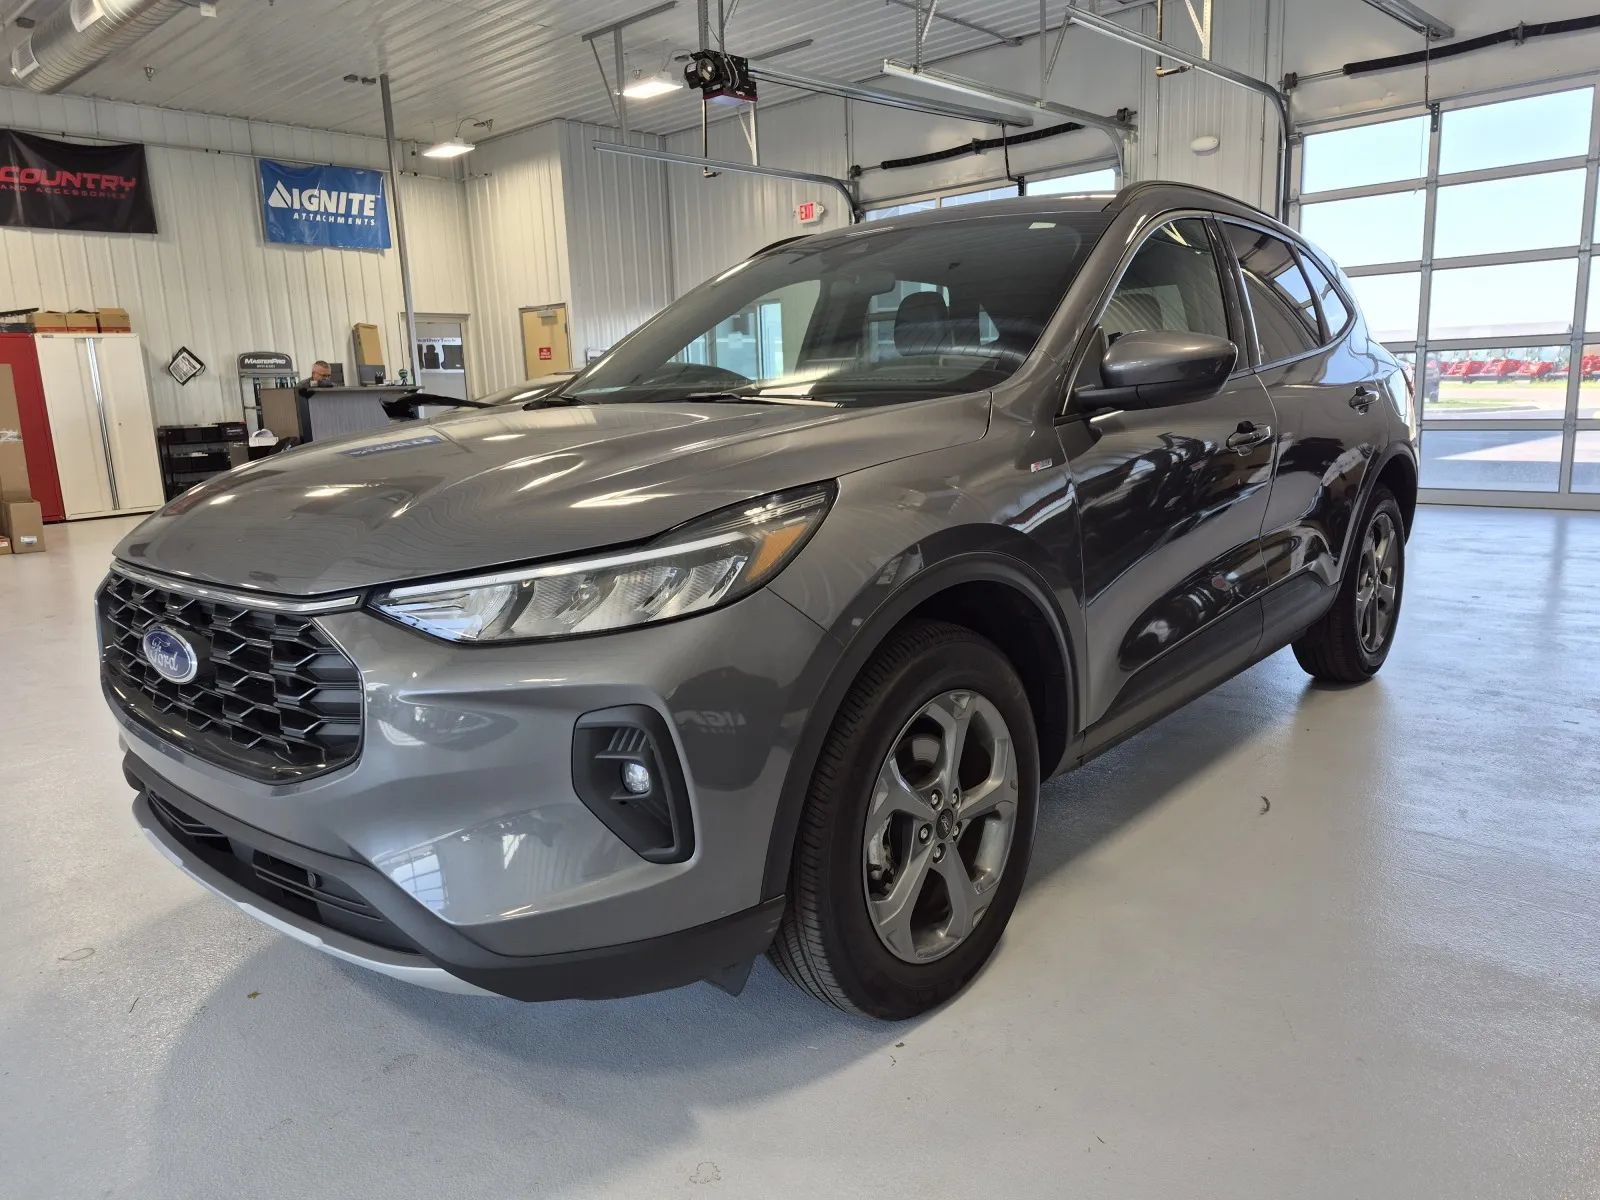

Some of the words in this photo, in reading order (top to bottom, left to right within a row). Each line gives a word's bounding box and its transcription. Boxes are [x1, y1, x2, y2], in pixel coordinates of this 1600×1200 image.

[0, 166, 136, 191] COUNTRY
[1, 184, 27, 192] AND
[36, 186, 128, 199] ACCESSORIES
[292, 188, 376, 217] IGNITE
[293, 212, 376, 226] ATTACHMENTS
